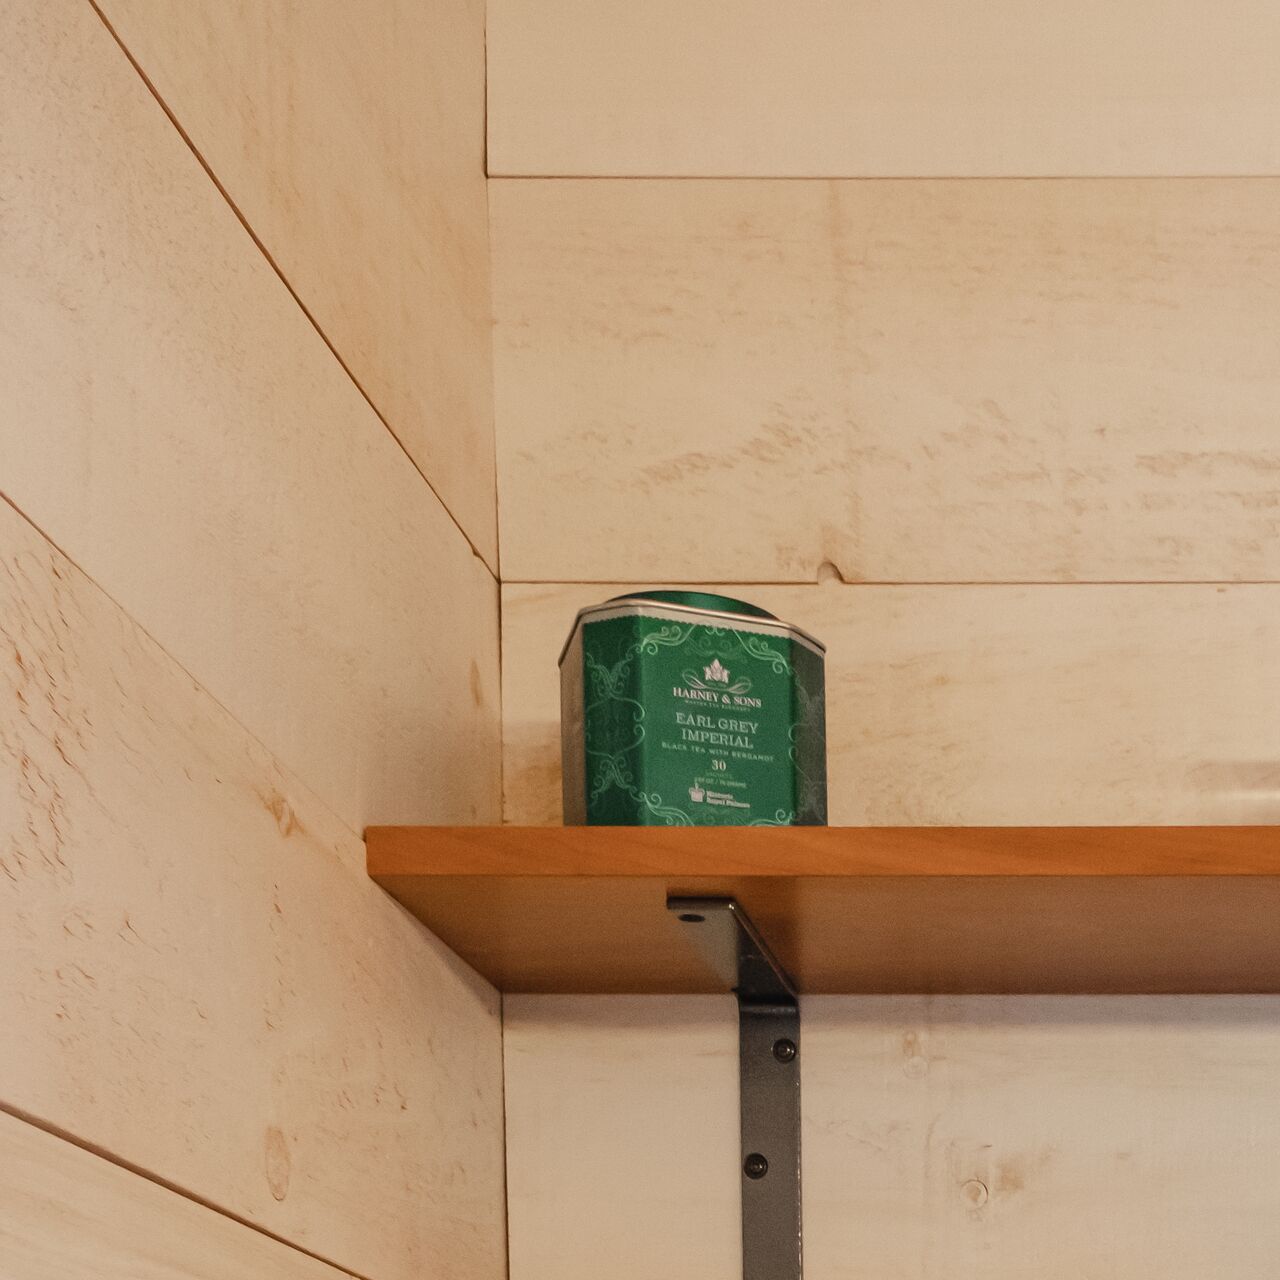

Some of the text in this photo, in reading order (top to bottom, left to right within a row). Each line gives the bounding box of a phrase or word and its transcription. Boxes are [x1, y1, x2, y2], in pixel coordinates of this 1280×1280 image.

[673, 687, 719, 702] HARNEY
[721, 693, 732, 704] &
[733, 695, 762, 708] SONS
[676, 712, 759, 735] EARL GREY
[661, 741, 687, 751] BLACK
[691, 745, 706, 753] TEA
[708, 748, 729, 756] WITH
[682, 728, 754, 749] IMPERIAL
[711, 759, 727, 772] 30
